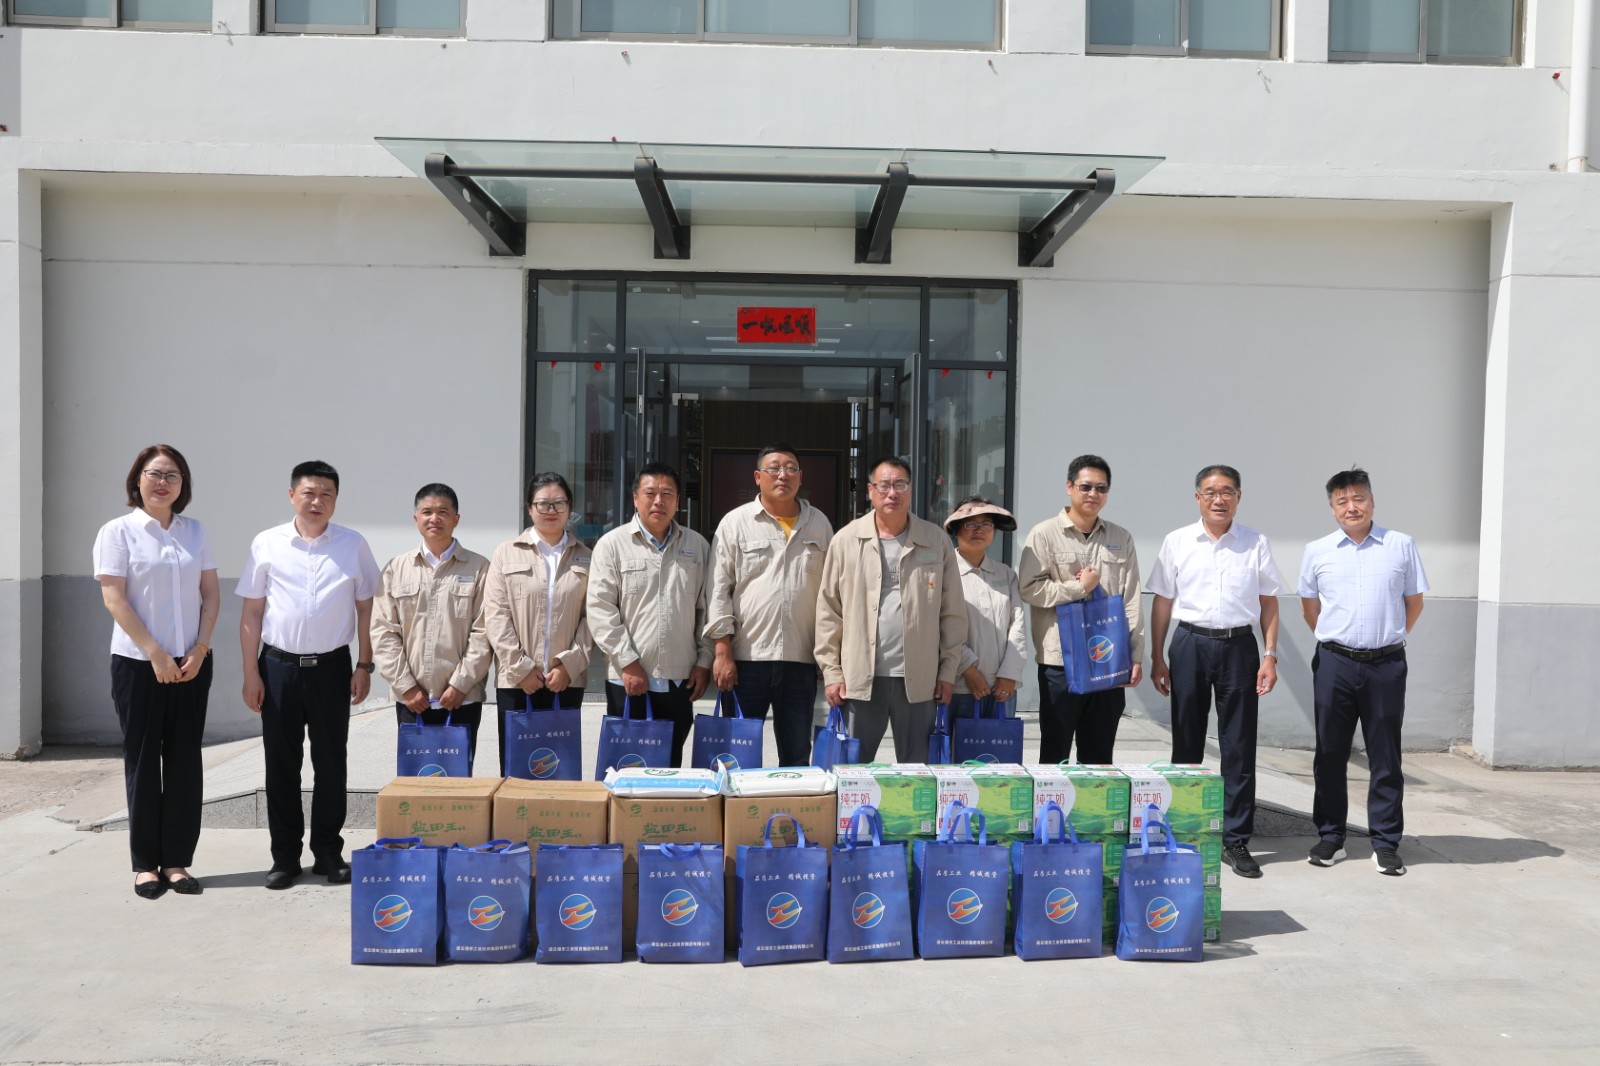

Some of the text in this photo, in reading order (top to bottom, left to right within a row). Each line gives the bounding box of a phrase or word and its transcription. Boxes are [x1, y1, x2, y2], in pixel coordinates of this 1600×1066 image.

[840, 792, 871, 806] 纯牛奶
[939, 792, 969, 806] 纯牛奶
[1133, 792, 1162, 805] 纯牛奶
[410, 820, 457, 835] 盐田王
[527, 824, 573, 839] 盐田王
[642, 822, 688, 836] 盐田王
